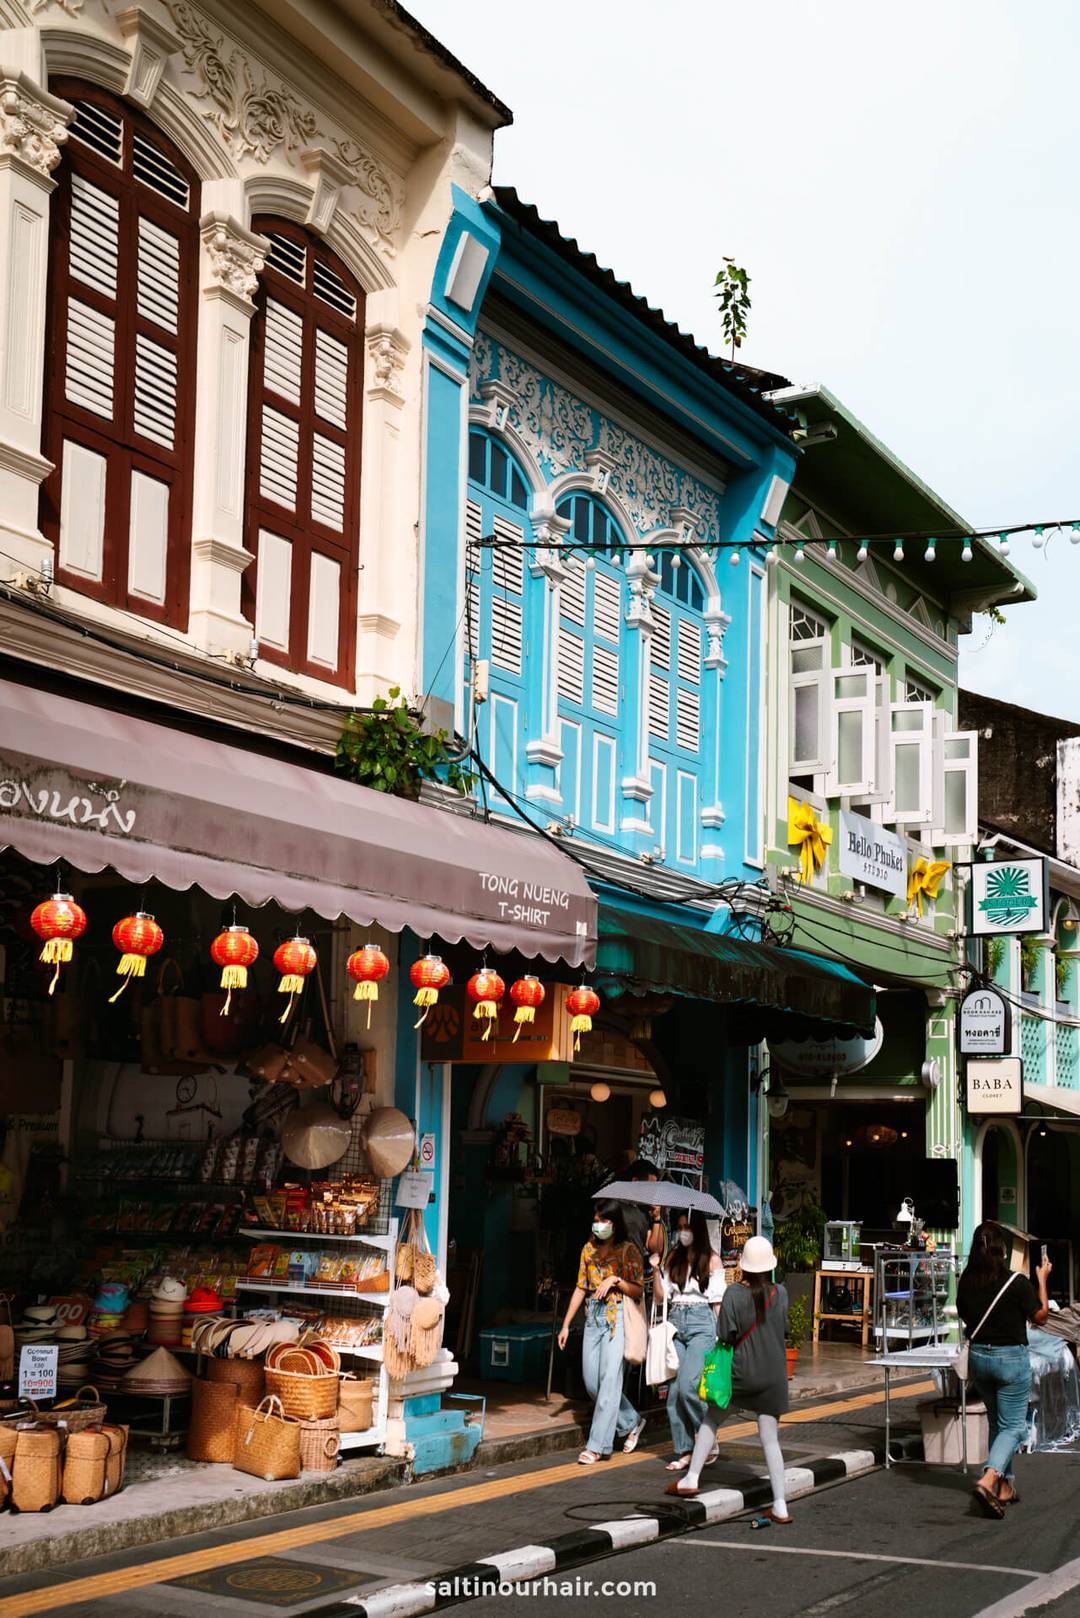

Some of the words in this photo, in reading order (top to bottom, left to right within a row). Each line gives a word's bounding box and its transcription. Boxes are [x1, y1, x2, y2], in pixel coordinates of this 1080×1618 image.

[848, 831, 872, 859] Hello
[874, 842, 903, 872] Phuket
[863, 862, 888, 880] STUDIO
[478, 872, 519, 899] TONG
[523, 883, 570, 910] NUENG
[498, 902, 551, 926] T-SHIRT
[972, 1079, 1012, 1090] BABA
[23, 1370, 28, 1378] 1
[38, 1369, 54, 1378] 100
